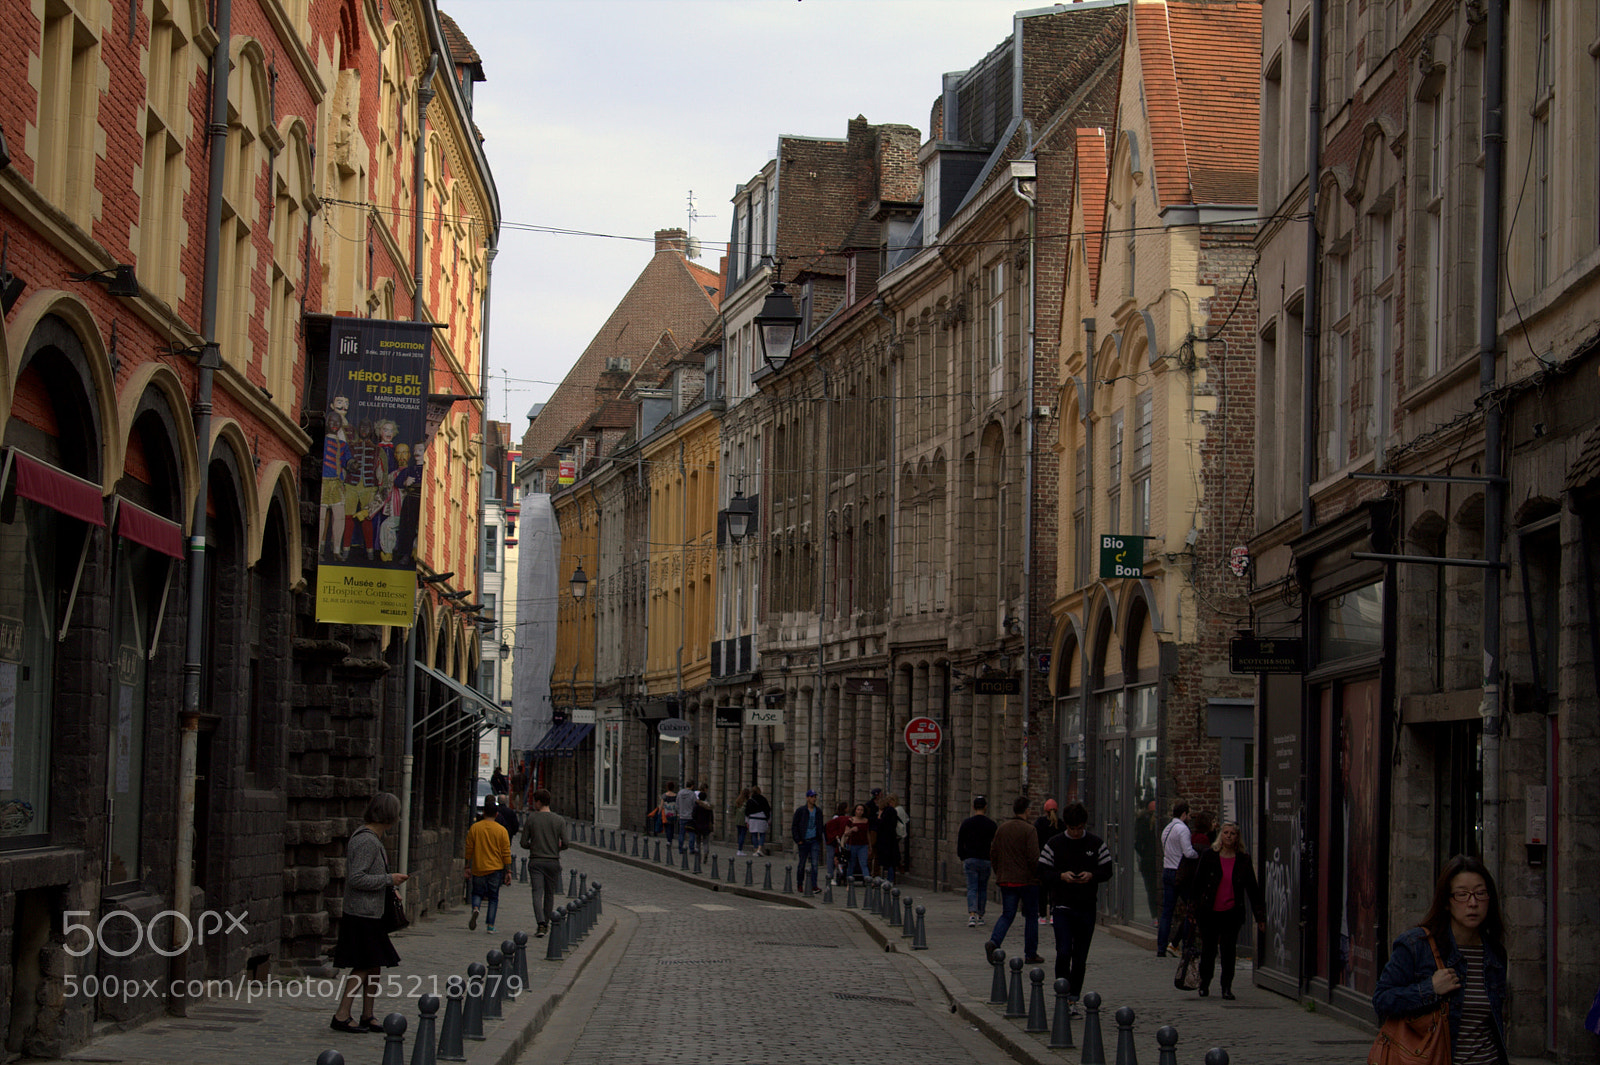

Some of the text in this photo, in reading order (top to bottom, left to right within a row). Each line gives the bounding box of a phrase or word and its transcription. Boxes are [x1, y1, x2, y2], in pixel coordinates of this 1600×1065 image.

[380, 340, 425, 350] EXPOSITION
[348, 369, 422, 385] HÉROS DE FIL
[366, 384, 421, 396] ET DE BOIS
[374, 395, 420, 404] MARIONNETTES
[1103, 537, 1124, 549] Bio
[1115, 564, 1140, 577] Bon
[343, 576, 387, 588] Musée de
[322, 585, 407, 599] l'Hospice Comtesse
[981, 681, 1014, 693] maje
[751, 711, 777, 721] Muse
